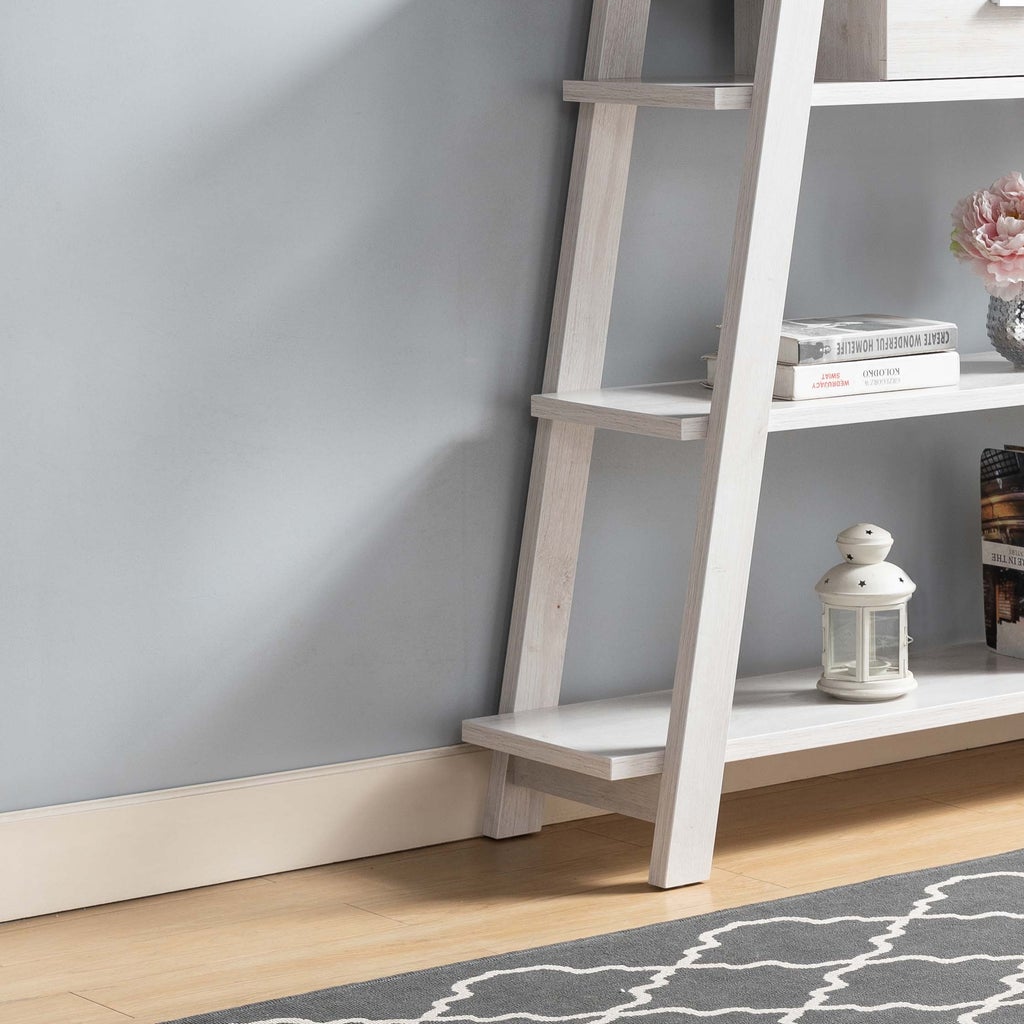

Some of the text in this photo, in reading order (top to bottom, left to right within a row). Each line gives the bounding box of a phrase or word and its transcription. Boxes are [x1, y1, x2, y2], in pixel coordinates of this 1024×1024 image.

[836, 330, 950, 356] CREATE WONDERFUL HOMELIFE
[991, 553, 1007, 564] THE
[1008, 556, 1017, 565] IN
